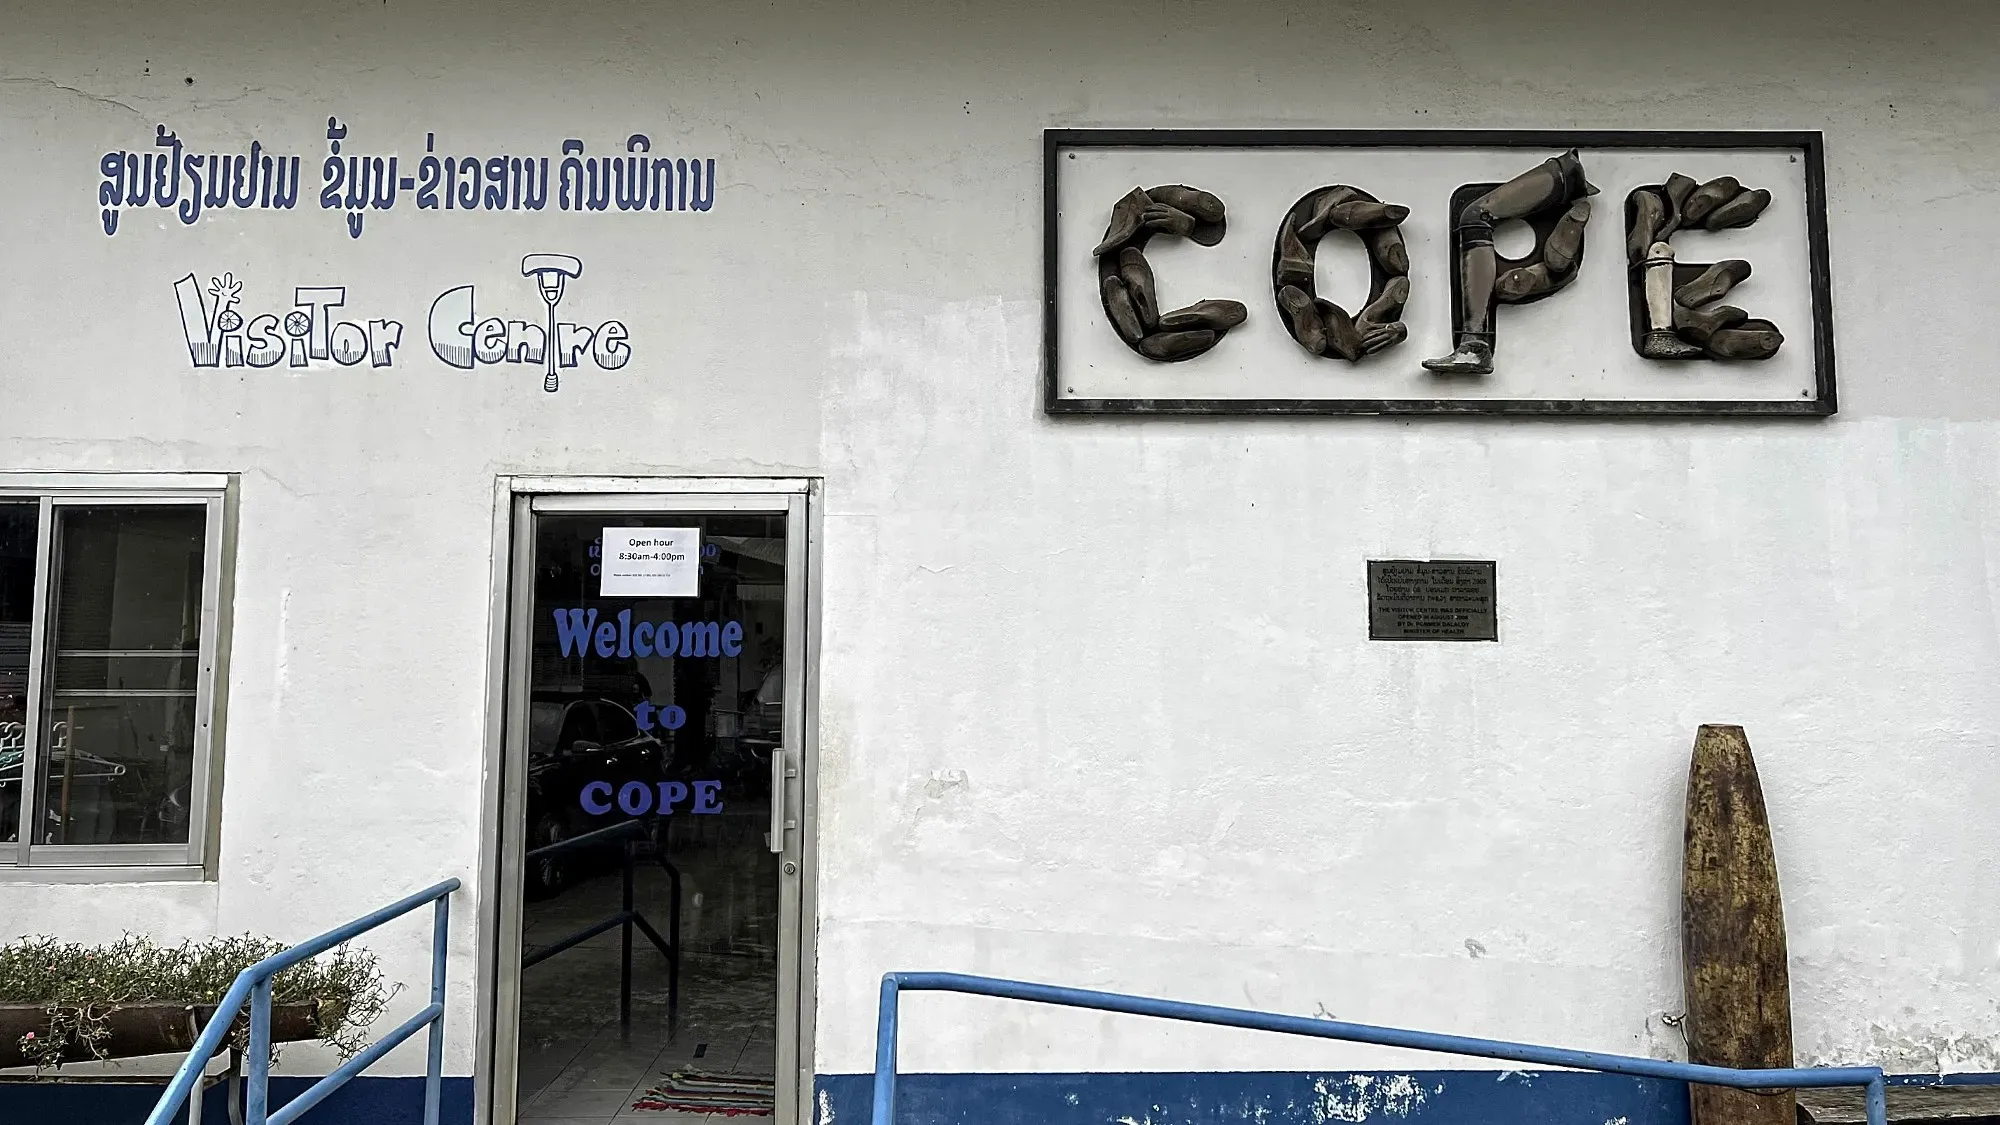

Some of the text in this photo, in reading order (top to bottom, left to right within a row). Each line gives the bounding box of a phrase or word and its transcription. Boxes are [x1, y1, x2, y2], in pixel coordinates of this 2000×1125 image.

[1093, 148, 1785, 376] COPE
[618, 552, 685, 562] 8:30am-4:00pm
[629, 538, 674, 548] Open hour
[553, 608, 744, 658] Welcome
[634, 701, 686, 730] to
[580, 780, 724, 815] COPE
